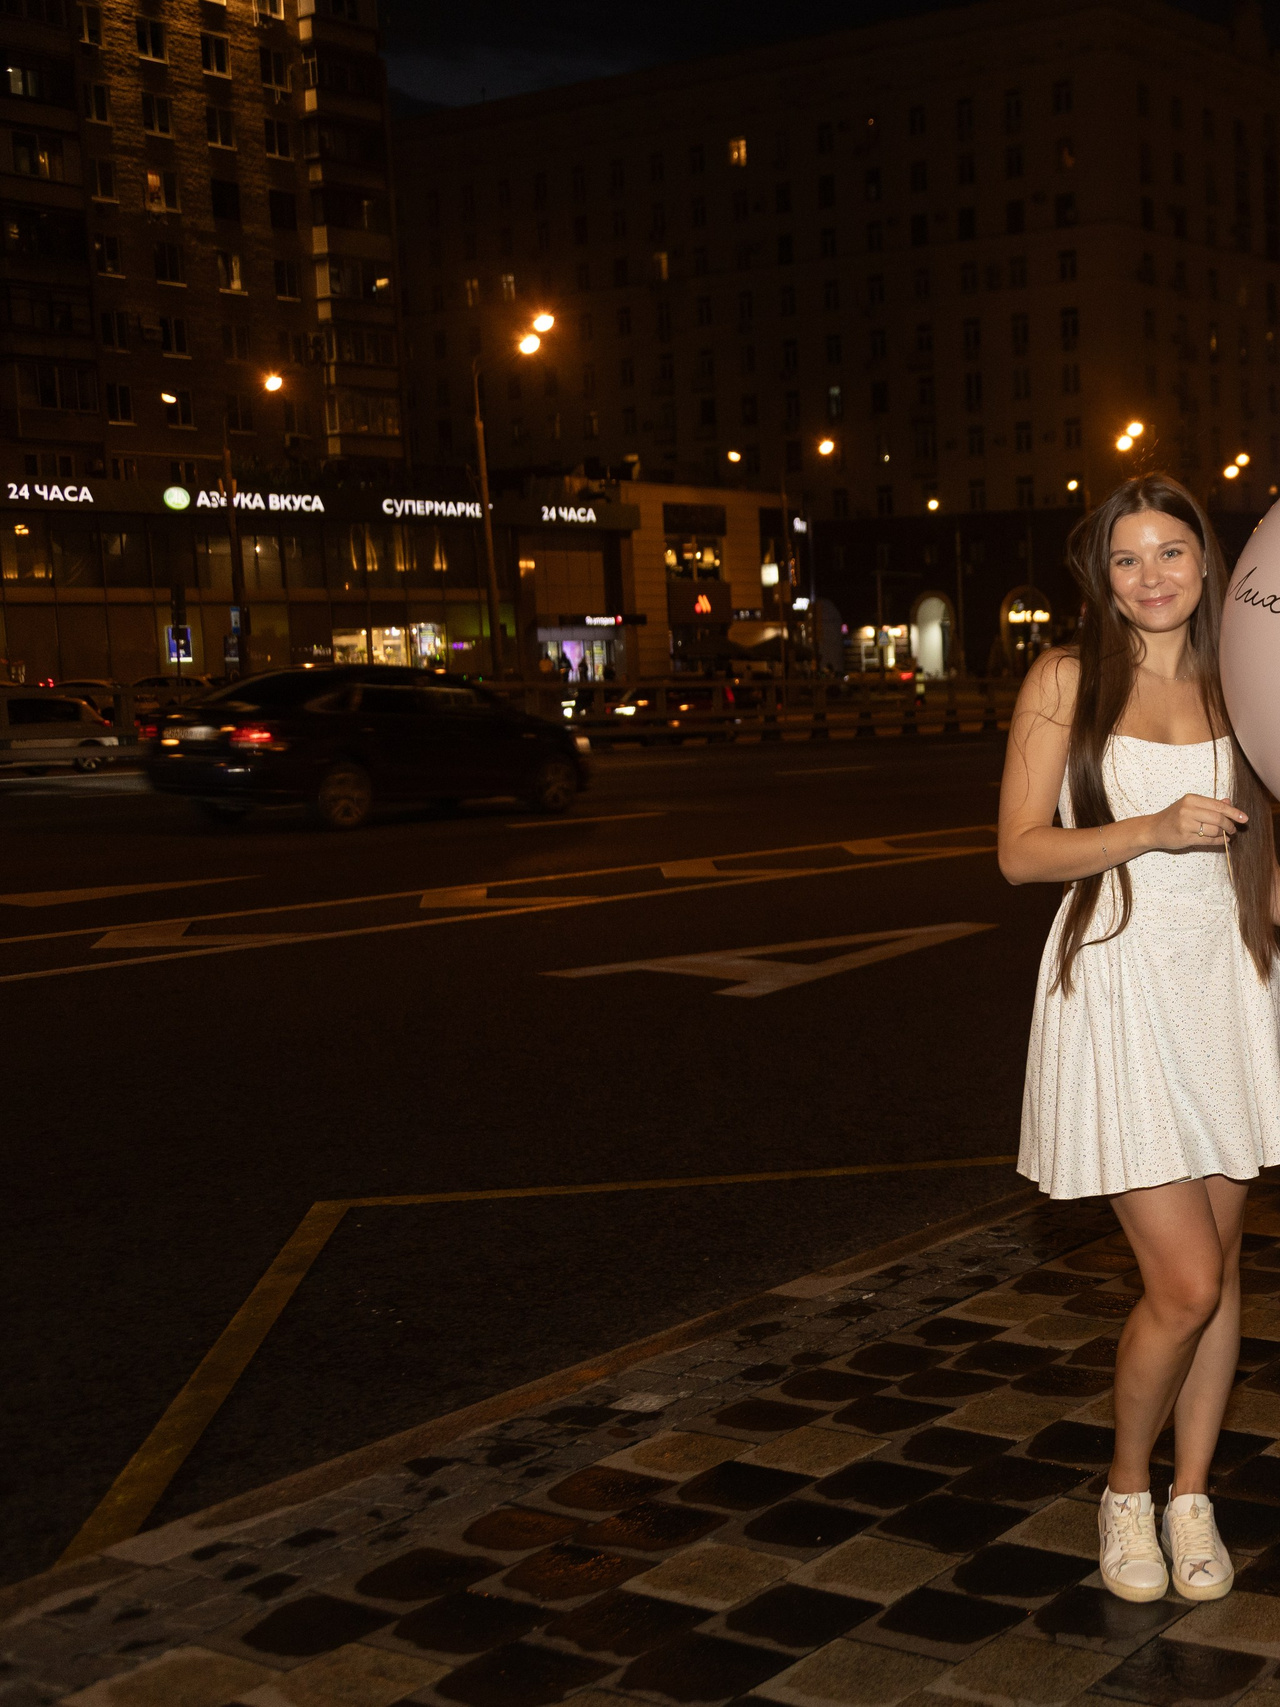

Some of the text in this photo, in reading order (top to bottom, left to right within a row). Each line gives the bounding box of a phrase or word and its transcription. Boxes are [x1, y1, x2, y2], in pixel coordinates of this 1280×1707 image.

[7, 482, 94, 503] 24 ЧАСА
[268, 493, 325, 513] ВКУСА
[382, 497, 493, 519] СУПЕРМАРКЕ
[541, 505, 597, 524] 24 ЧАСА
